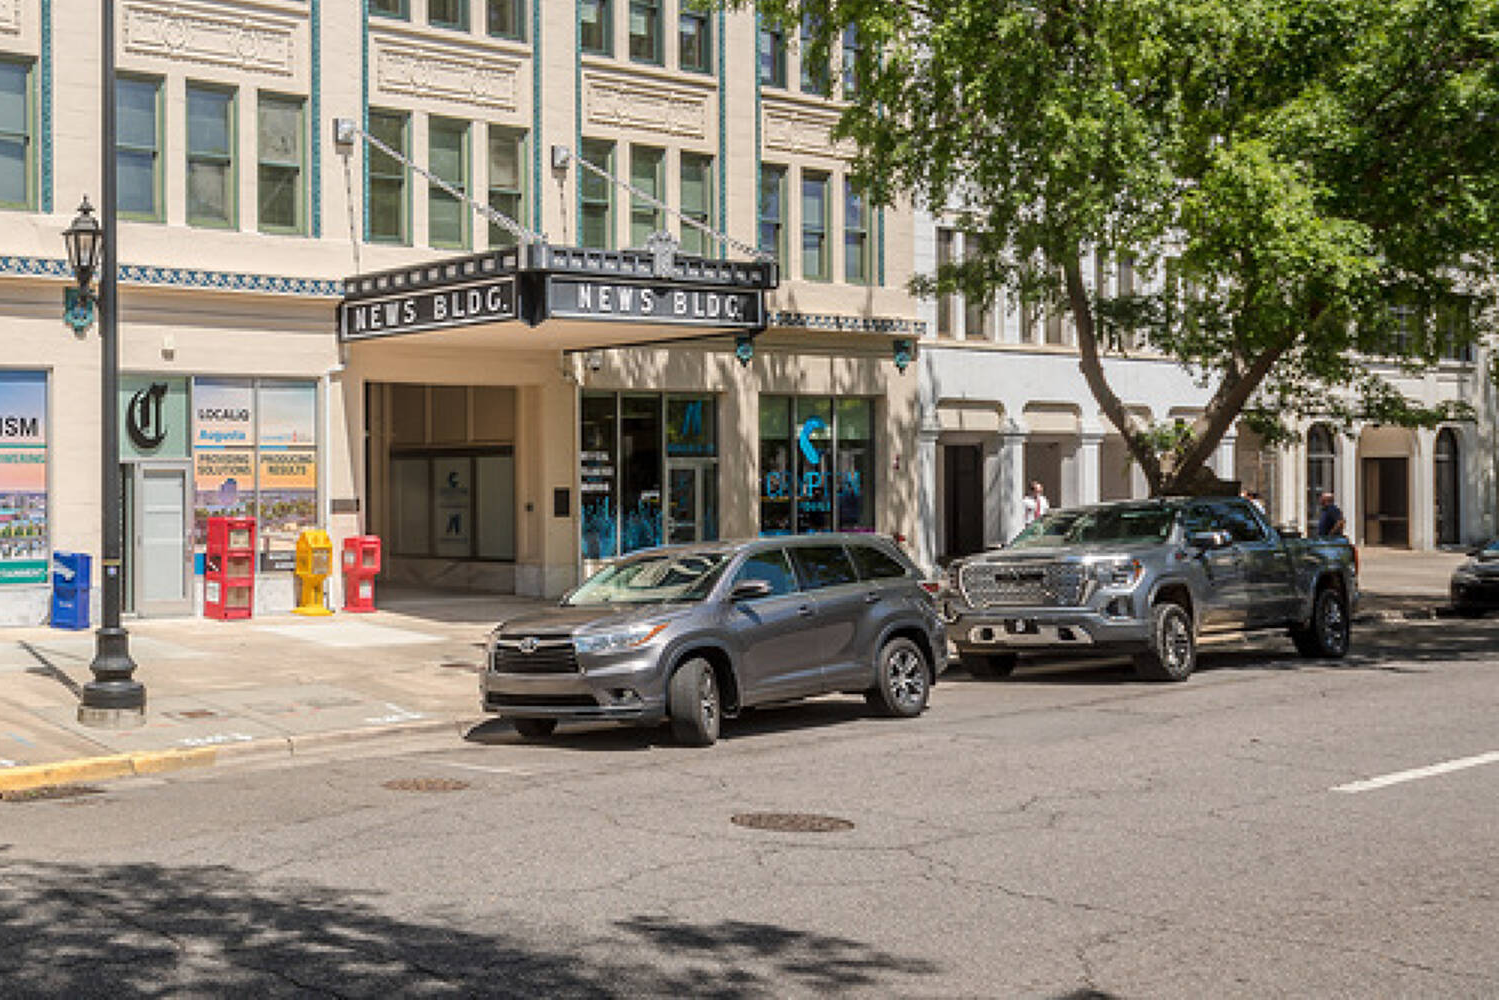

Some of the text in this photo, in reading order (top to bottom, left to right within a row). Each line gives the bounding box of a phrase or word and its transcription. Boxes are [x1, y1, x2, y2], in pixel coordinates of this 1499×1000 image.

[578, 283, 654, 313] NEWS
[355, 286, 508, 332] NEWS BLDG.
[197, 454, 250, 464] PROVIDING
[260, 454, 313, 465] PRODUCING
[197, 465, 252, 476] SOLUTIONS
[268, 466, 307, 476] RESULTS
